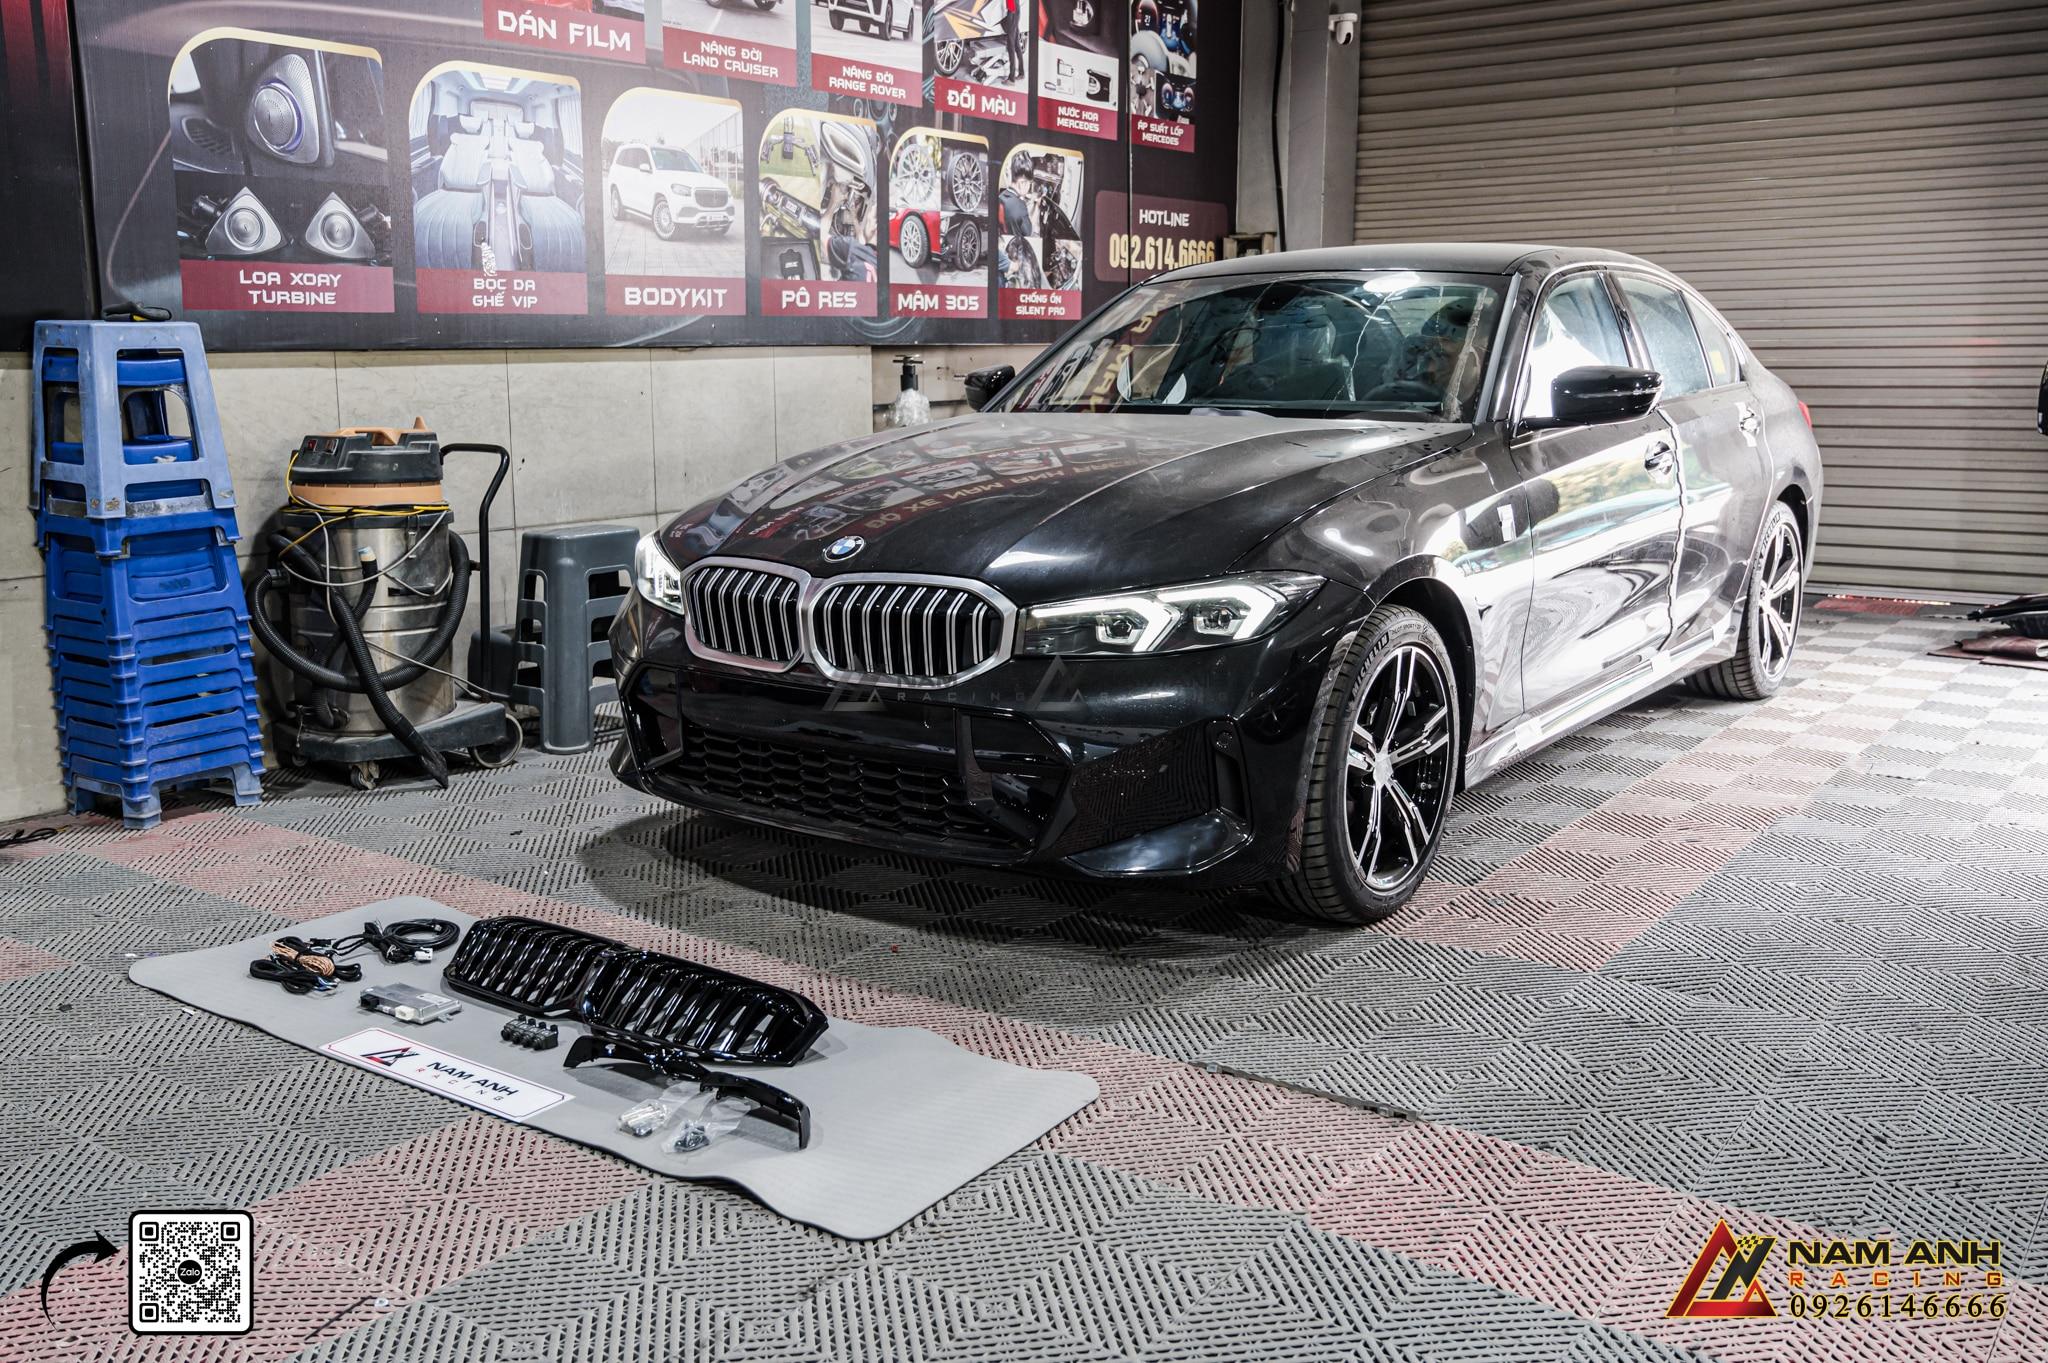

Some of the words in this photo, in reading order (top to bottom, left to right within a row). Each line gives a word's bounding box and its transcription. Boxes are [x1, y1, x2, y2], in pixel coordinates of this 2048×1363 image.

[497, 9, 557, 40] DÁN
[568, 22, 631, 52] FILM
[700, 40, 736, 57] NÂNG
[683, 51, 719, 68] LAND
[724, 59, 779, 78] CRUISER
[842, 65, 872, 80] NÂNG
[828, 76, 866, 92] RANGE
[870, 84, 906, 99] ROVER
[981, 94, 1017, 116] MÀU
[1056, 117, 1100, 133] MERCEDES
[1081, 110, 1099, 122] HOA
[1142, 132, 1180, 146] MERCEDES
[1139, 209, 1190, 227] HOTLINE
[1109, 233, 1216, 271] 092.614.6666
[239, 269, 281, 286] LOA
[289, 272, 342, 288] XOAY
[473, 278, 507, 293] BỌC
[513, 279, 536, 292] DA
[248, 288, 337, 306] TURBINE
[511, 295, 538, 308] VIP
[624, 287, 728, 309] BODYKIT
[782, 286, 810, 309] PÔ
[818, 291, 858, 309] RES
[898, 289, 939, 312] MÂM
[1015, 305, 1046, 316] SILENT
[1047, 306, 1066, 317] PRO
[1351, 631, 1389, 698] MICHELIN
[415, 1066, 504, 1102] RACING
[426, 1061, 474, 1081] NAM
[472, 1078, 520, 1097] ANH
